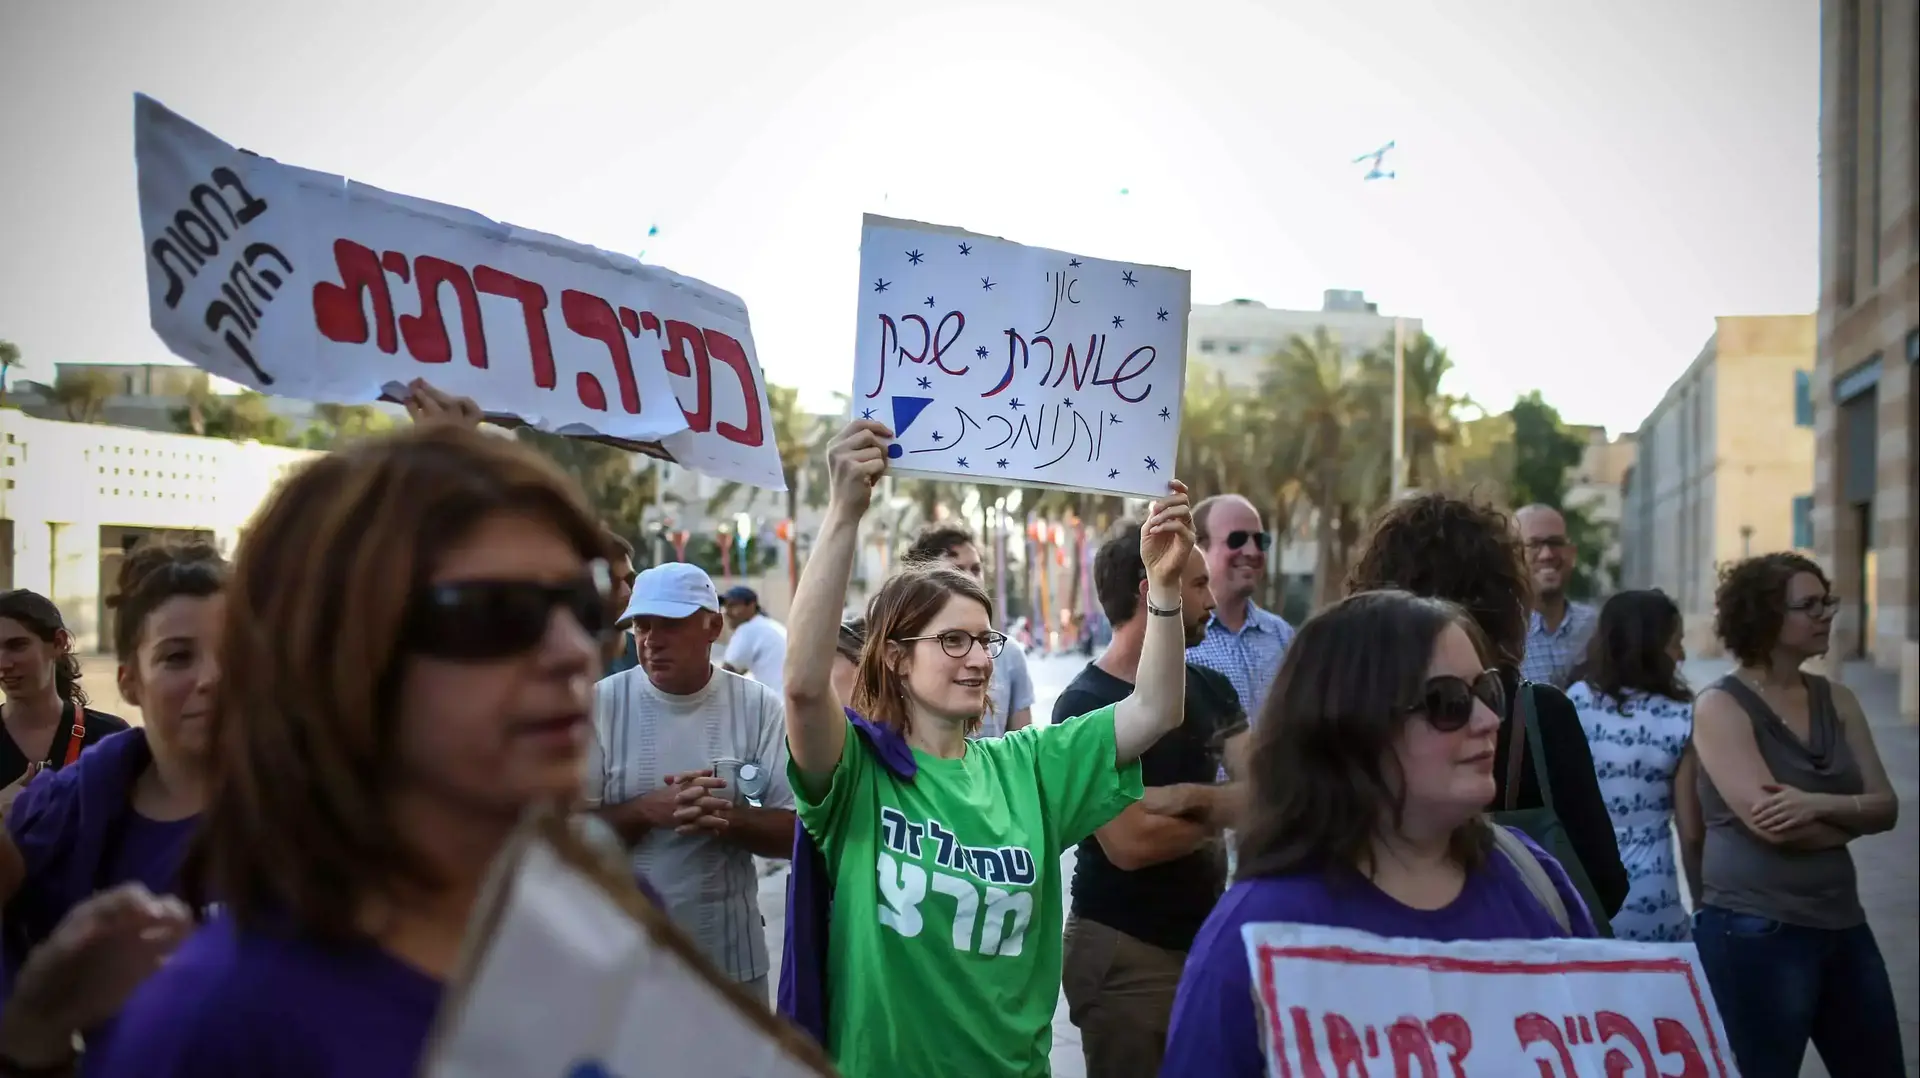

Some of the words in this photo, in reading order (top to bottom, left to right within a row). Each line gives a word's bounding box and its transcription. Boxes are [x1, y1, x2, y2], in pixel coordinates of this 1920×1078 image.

[151, 166, 267, 309] בחסות
[205, 242, 294, 385] החוק
[312, 238, 556, 391] דתית
[866, 311, 969, 398] שבת
[1035, 271, 1081, 334] אני
[561, 289, 764, 448] כפייה
[981, 328, 1156, 402] שומרת
[881, 806, 924, 860] זה
